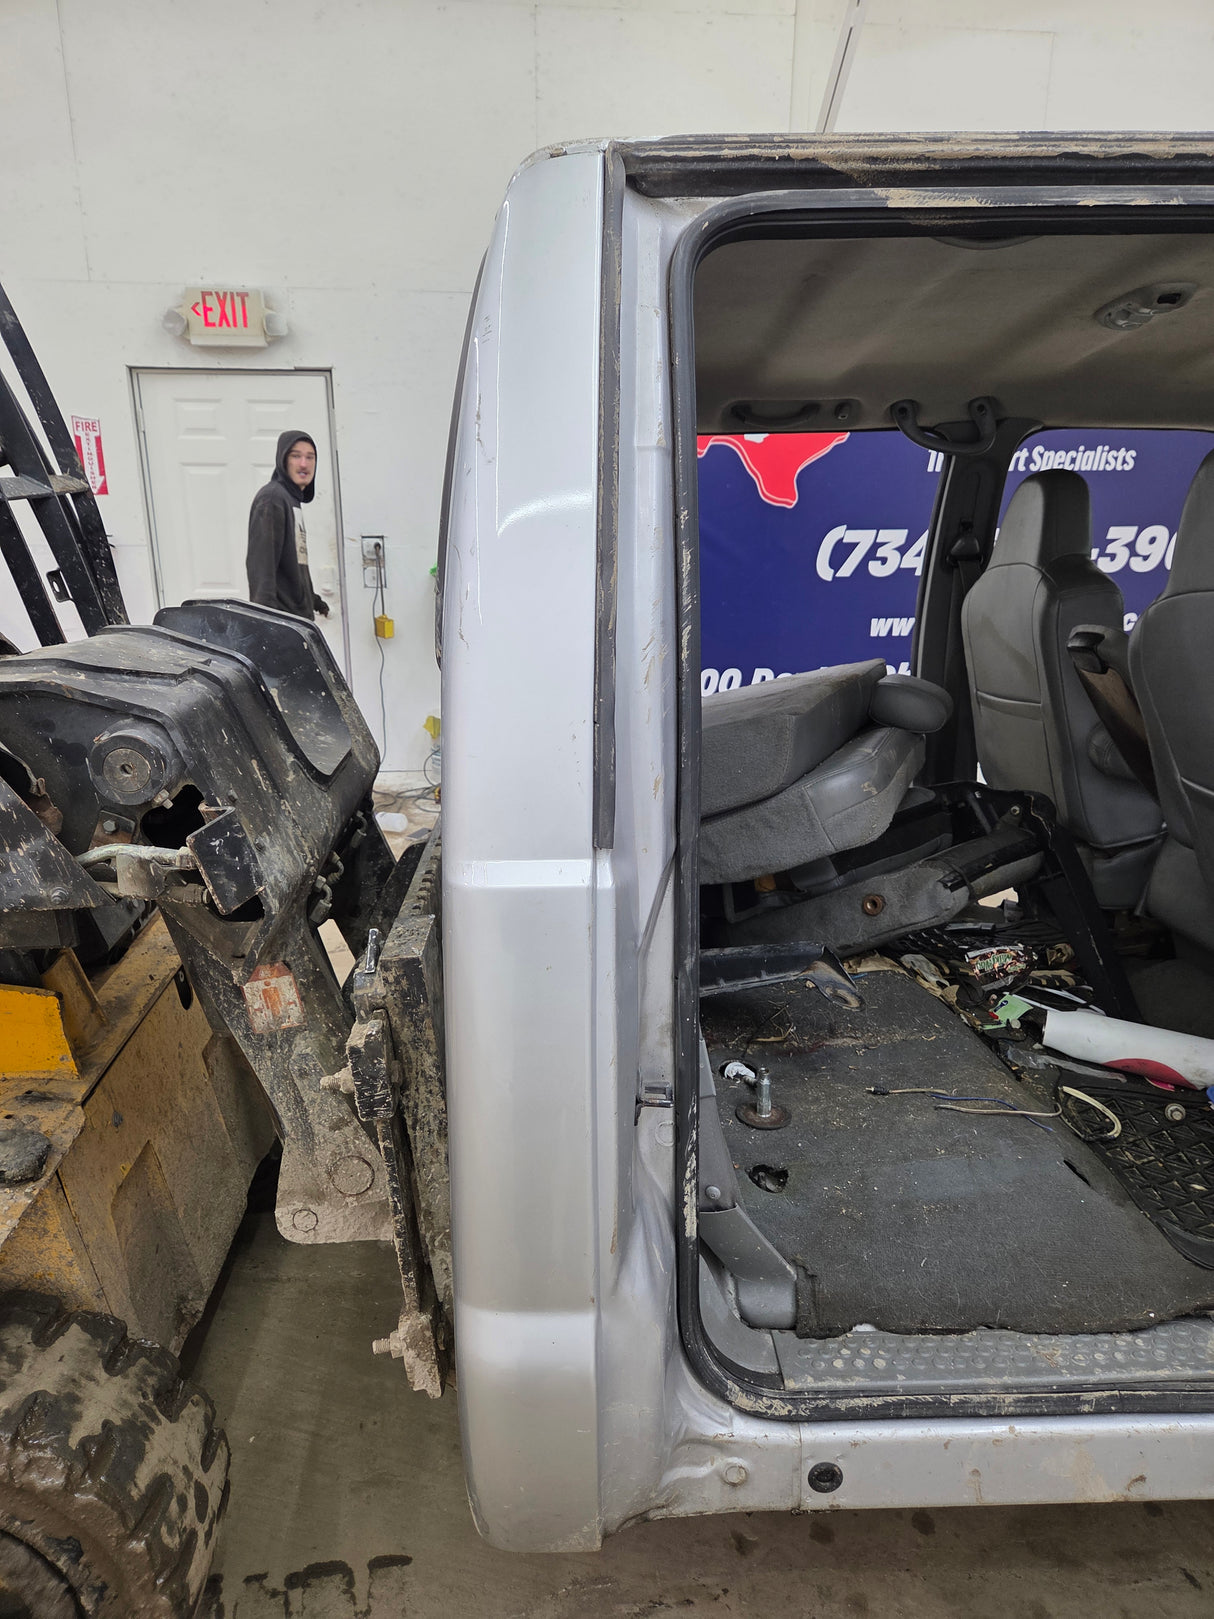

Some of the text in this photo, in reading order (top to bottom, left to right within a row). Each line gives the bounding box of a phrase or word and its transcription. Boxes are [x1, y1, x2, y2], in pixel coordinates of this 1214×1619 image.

[201, 291, 249, 328] EXIT
[75, 421, 98, 432] FIRE
[1029, 445, 1136, 472] Specialists
[816, 525, 929, 582] (734
